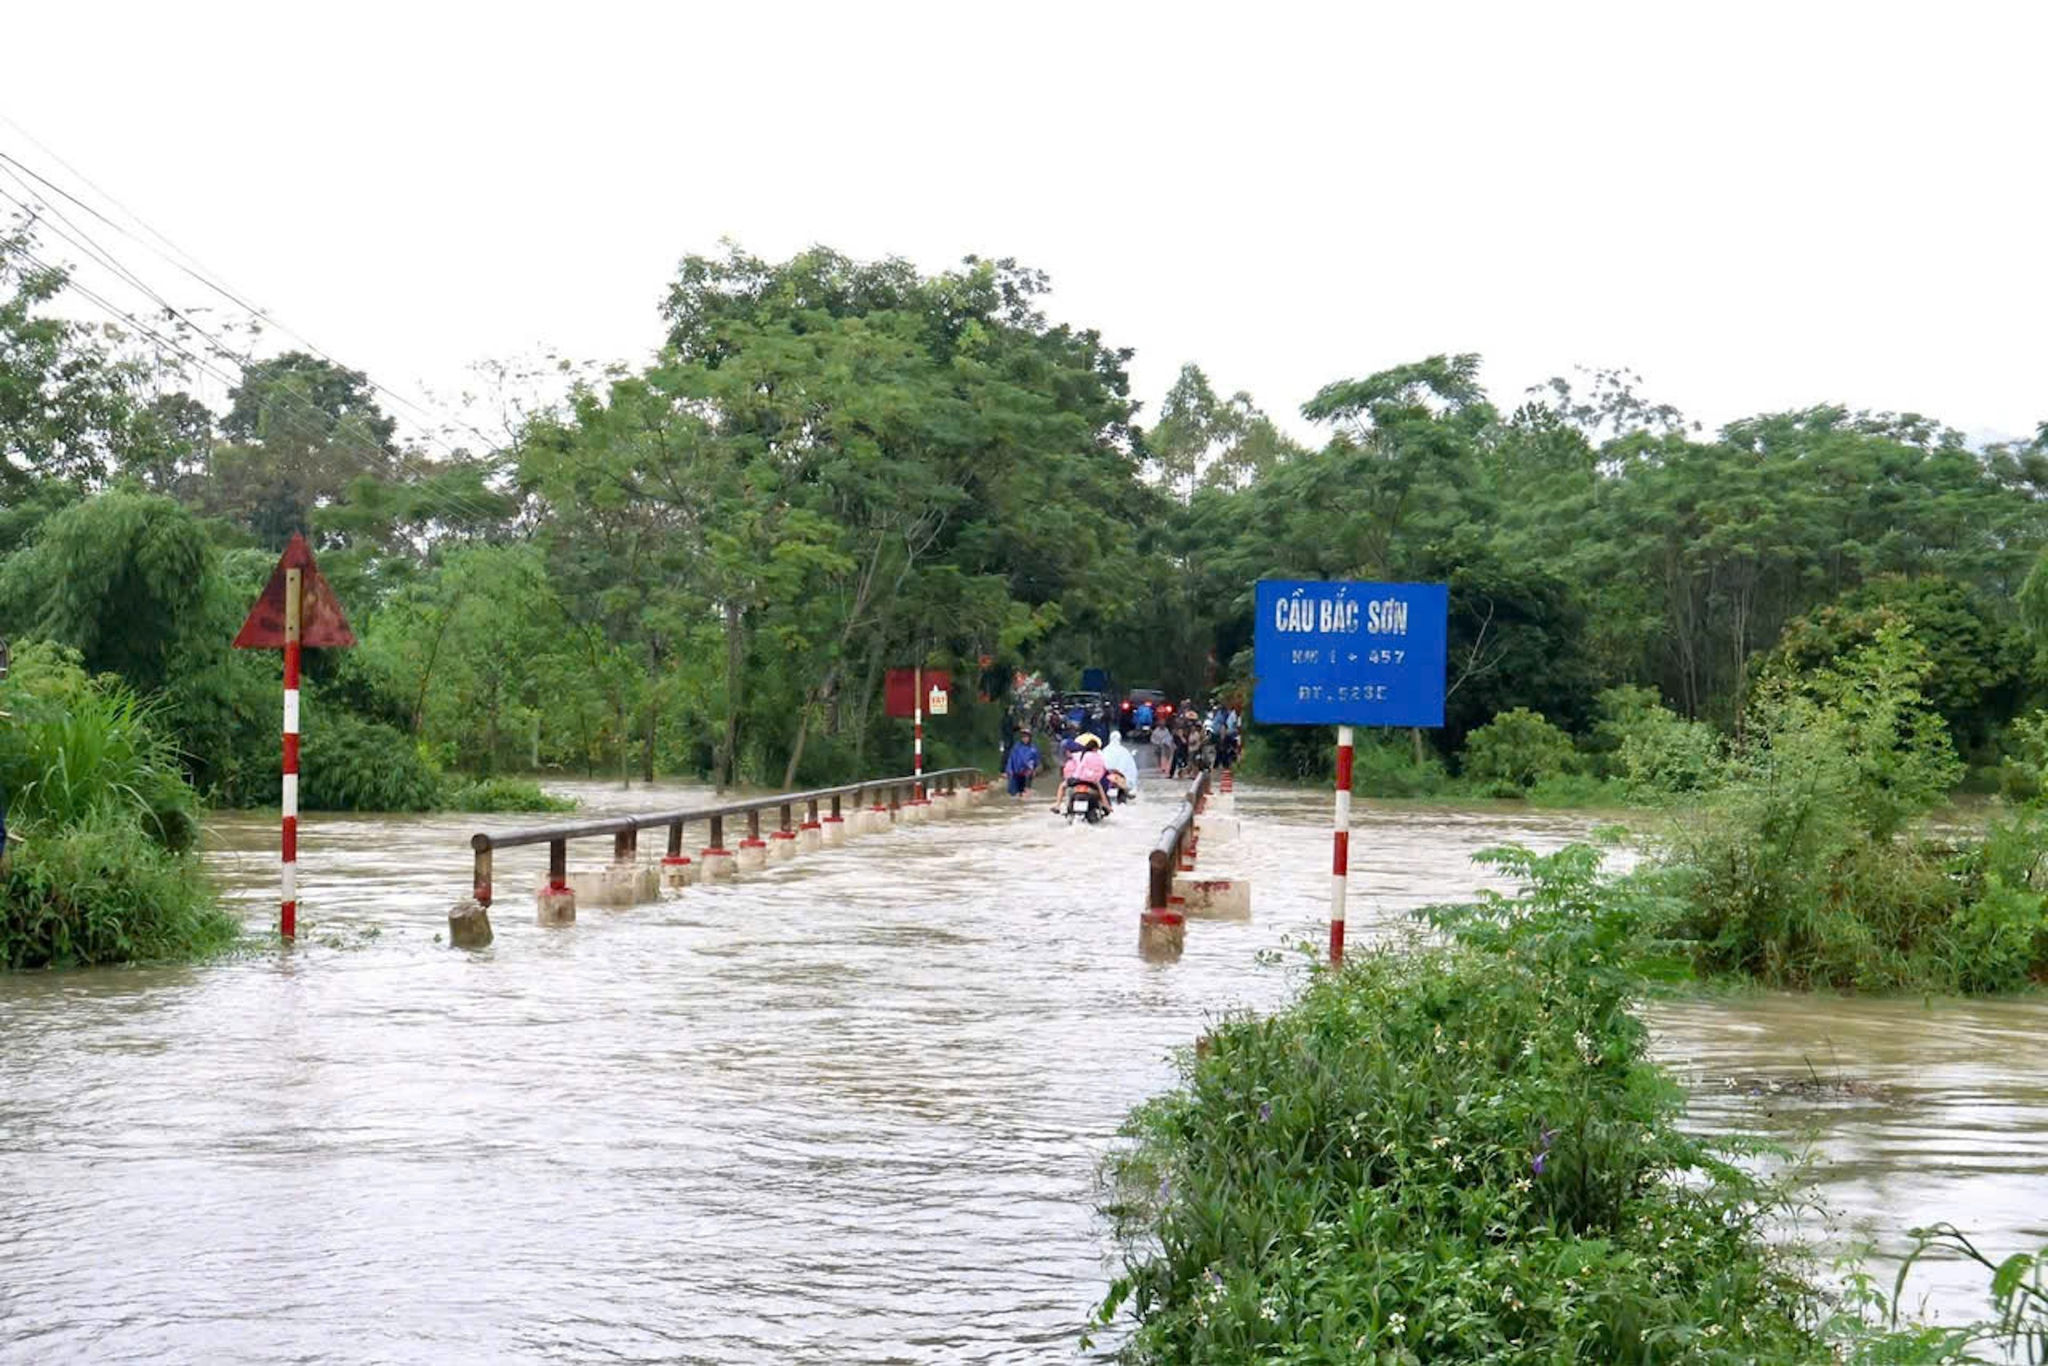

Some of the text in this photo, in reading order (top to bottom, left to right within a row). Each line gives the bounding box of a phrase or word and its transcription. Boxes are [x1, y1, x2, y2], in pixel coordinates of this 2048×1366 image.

[1275, 586, 1408, 636] CẦU BẮC SƠN
[1368, 649, 1406, 664] 457
